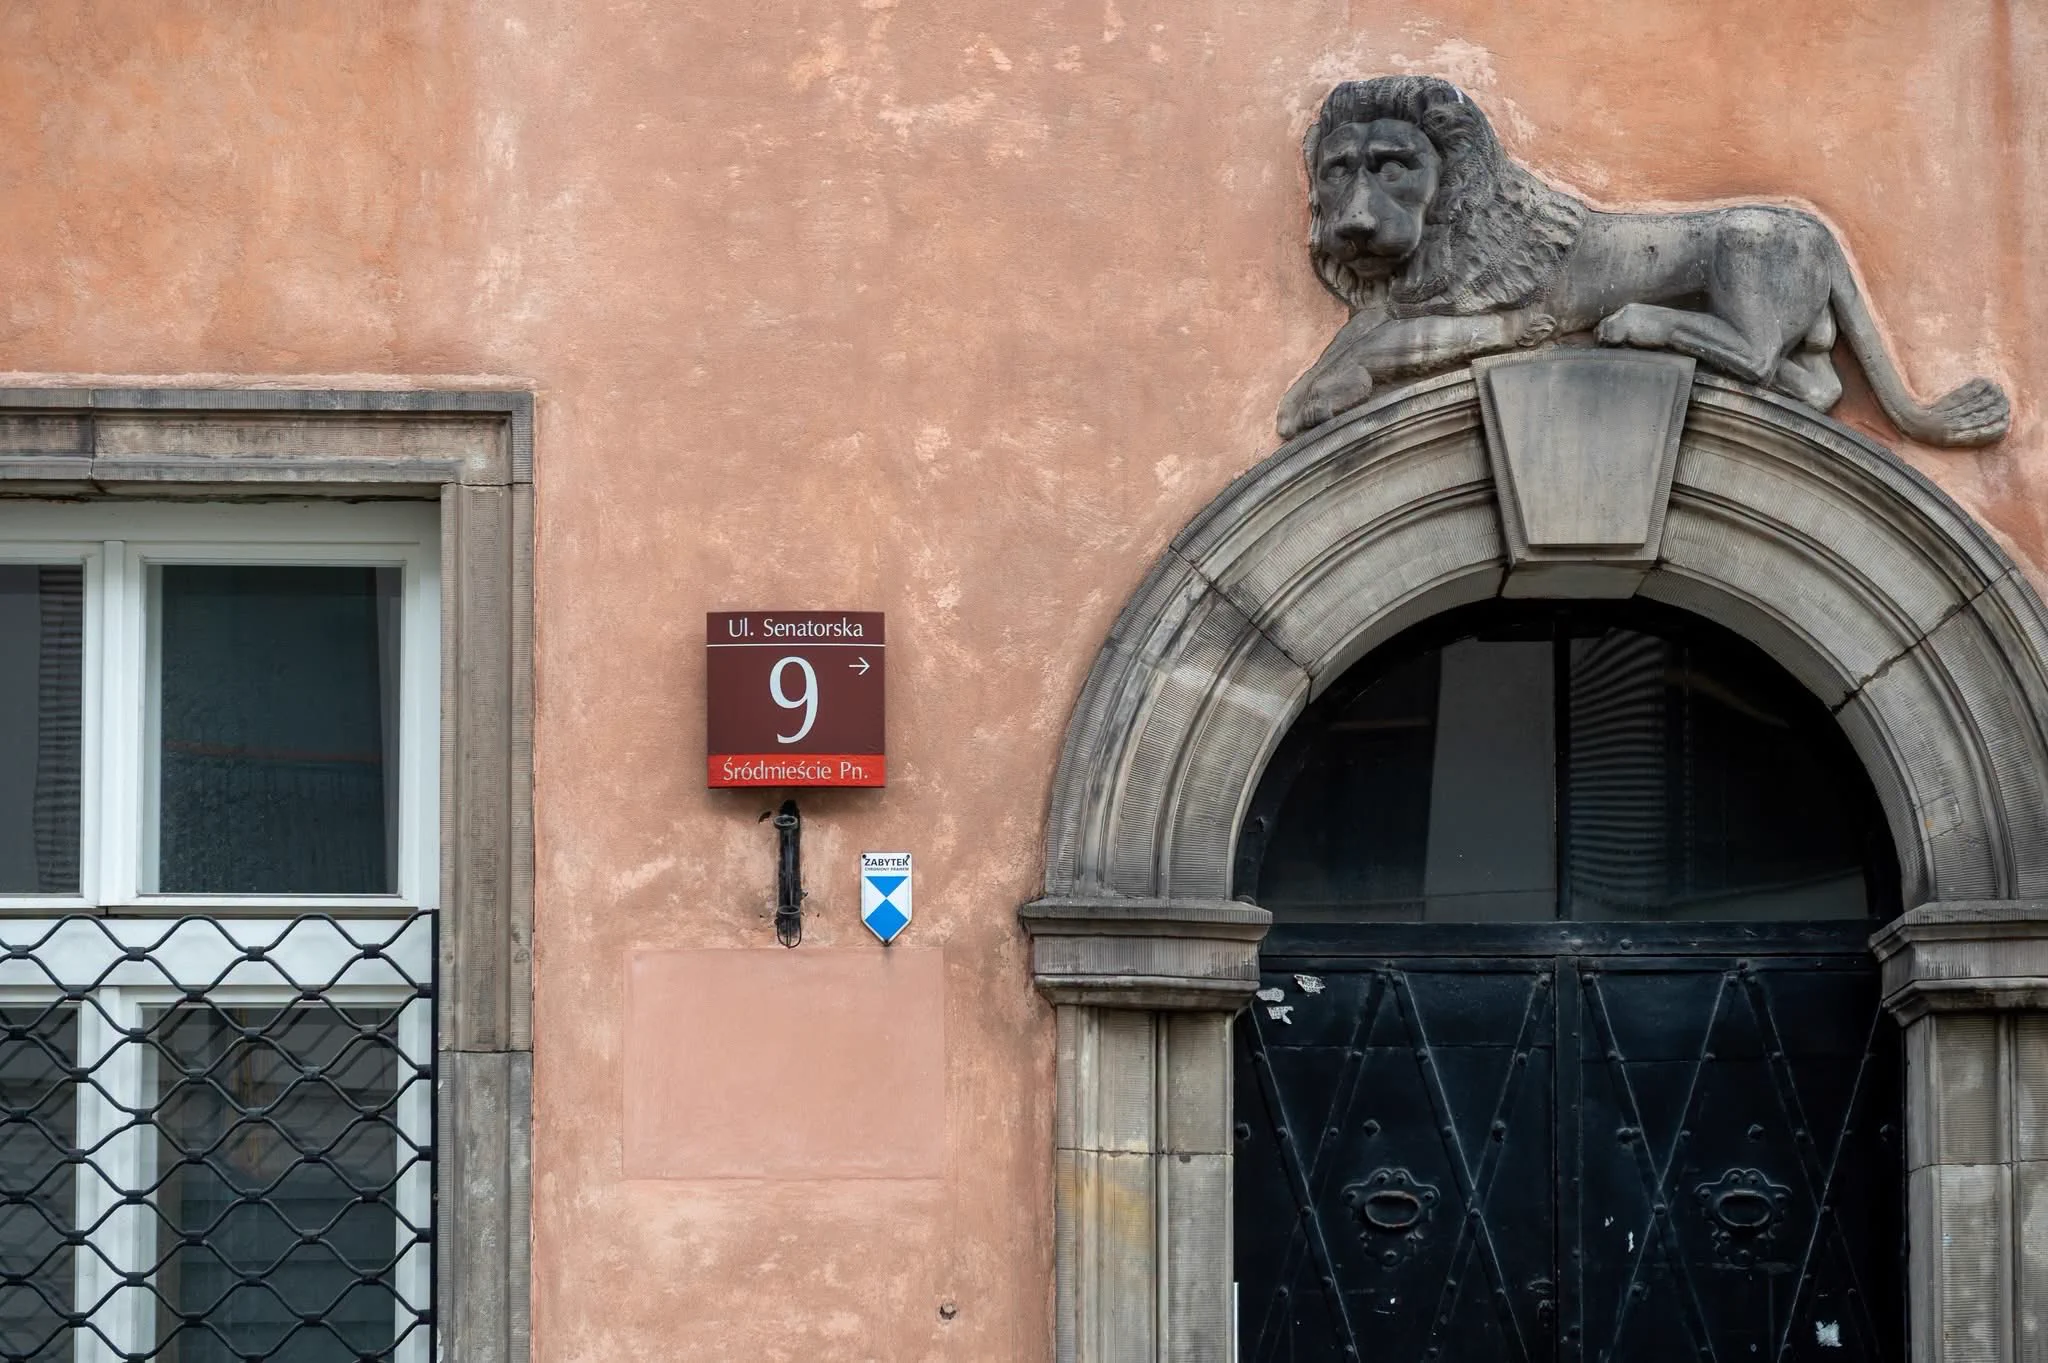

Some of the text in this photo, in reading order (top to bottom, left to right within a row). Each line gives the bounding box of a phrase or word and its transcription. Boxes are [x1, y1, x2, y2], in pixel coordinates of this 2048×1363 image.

[728, 617, 864, 637] Ul. Senatorska
[769, 656, 819, 744] 9
[723, 757, 868, 781] Śródmieście Pn.
[864, 858, 909, 866] ZABYTEK
